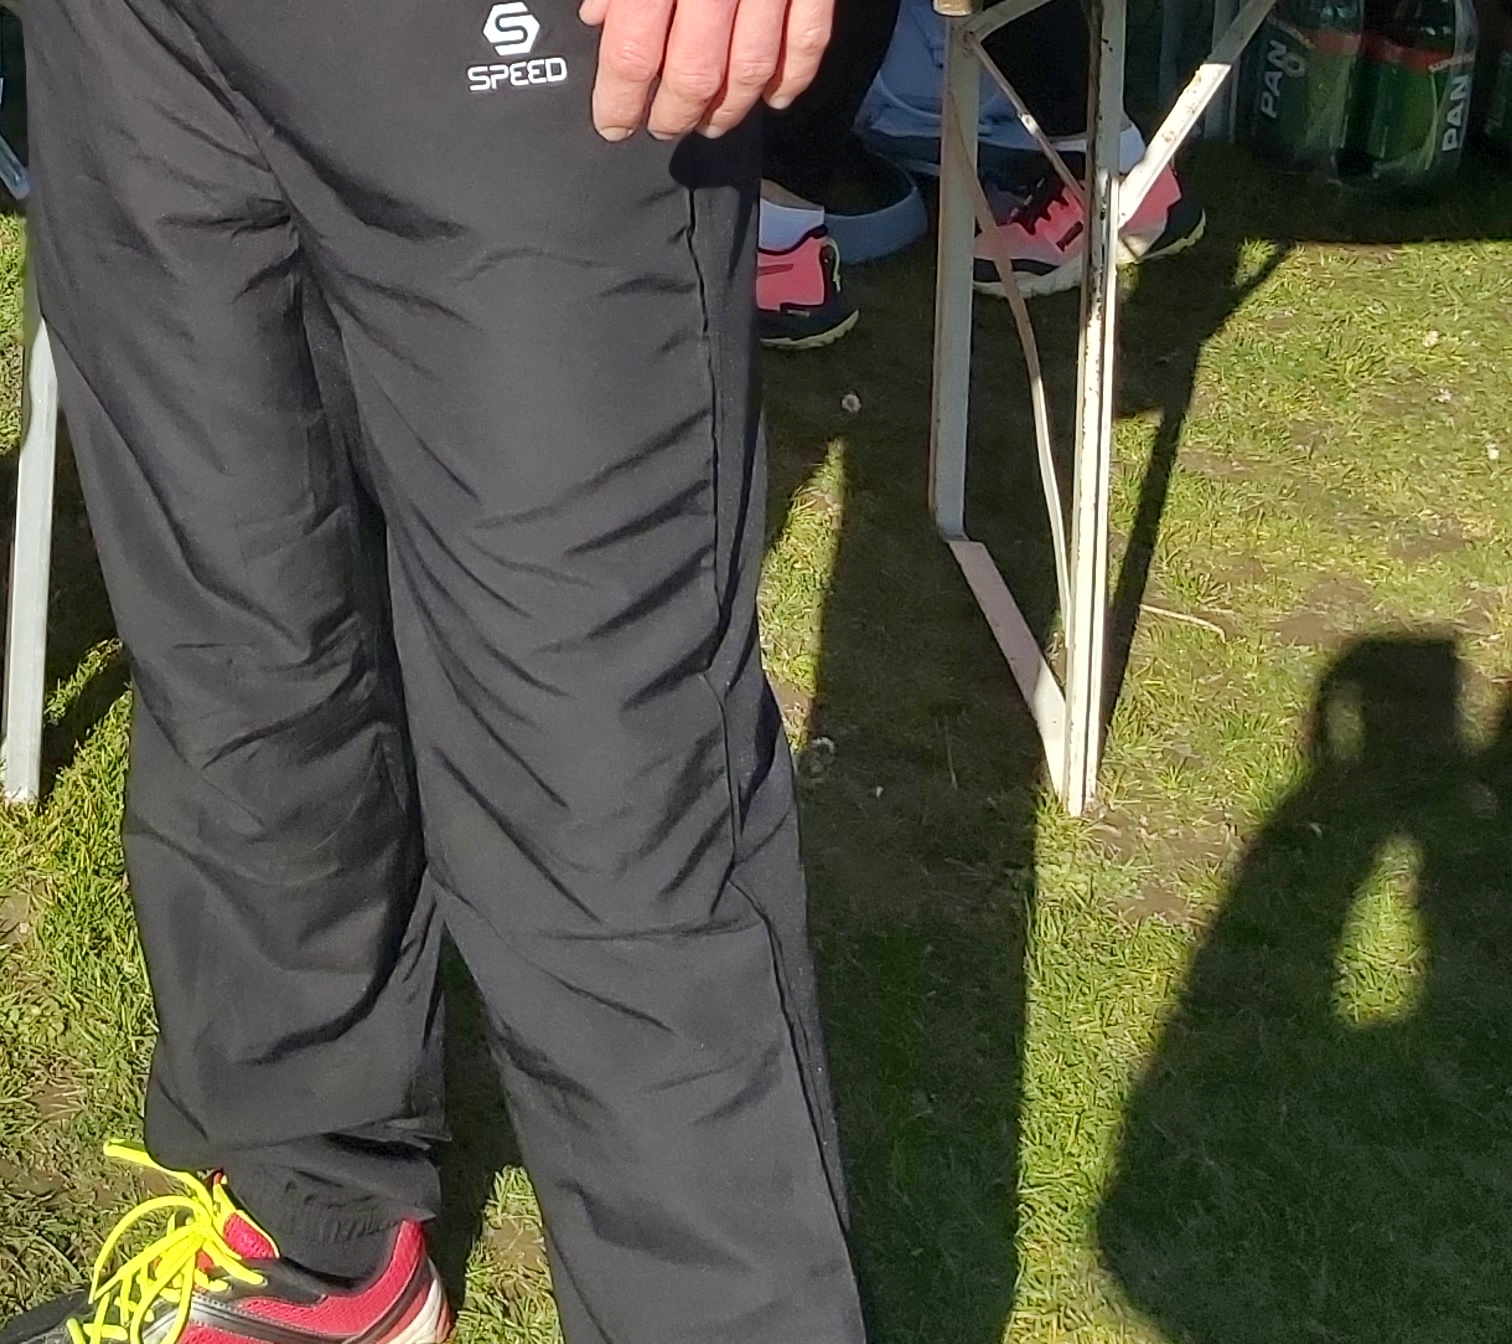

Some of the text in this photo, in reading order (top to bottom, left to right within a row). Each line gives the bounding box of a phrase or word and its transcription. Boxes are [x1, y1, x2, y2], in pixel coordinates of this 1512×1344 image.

[467, 57, 568, 91] SPEED
[1260, 40, 1288, 119] PAN
[1442, 74, 1470, 152] PAN
